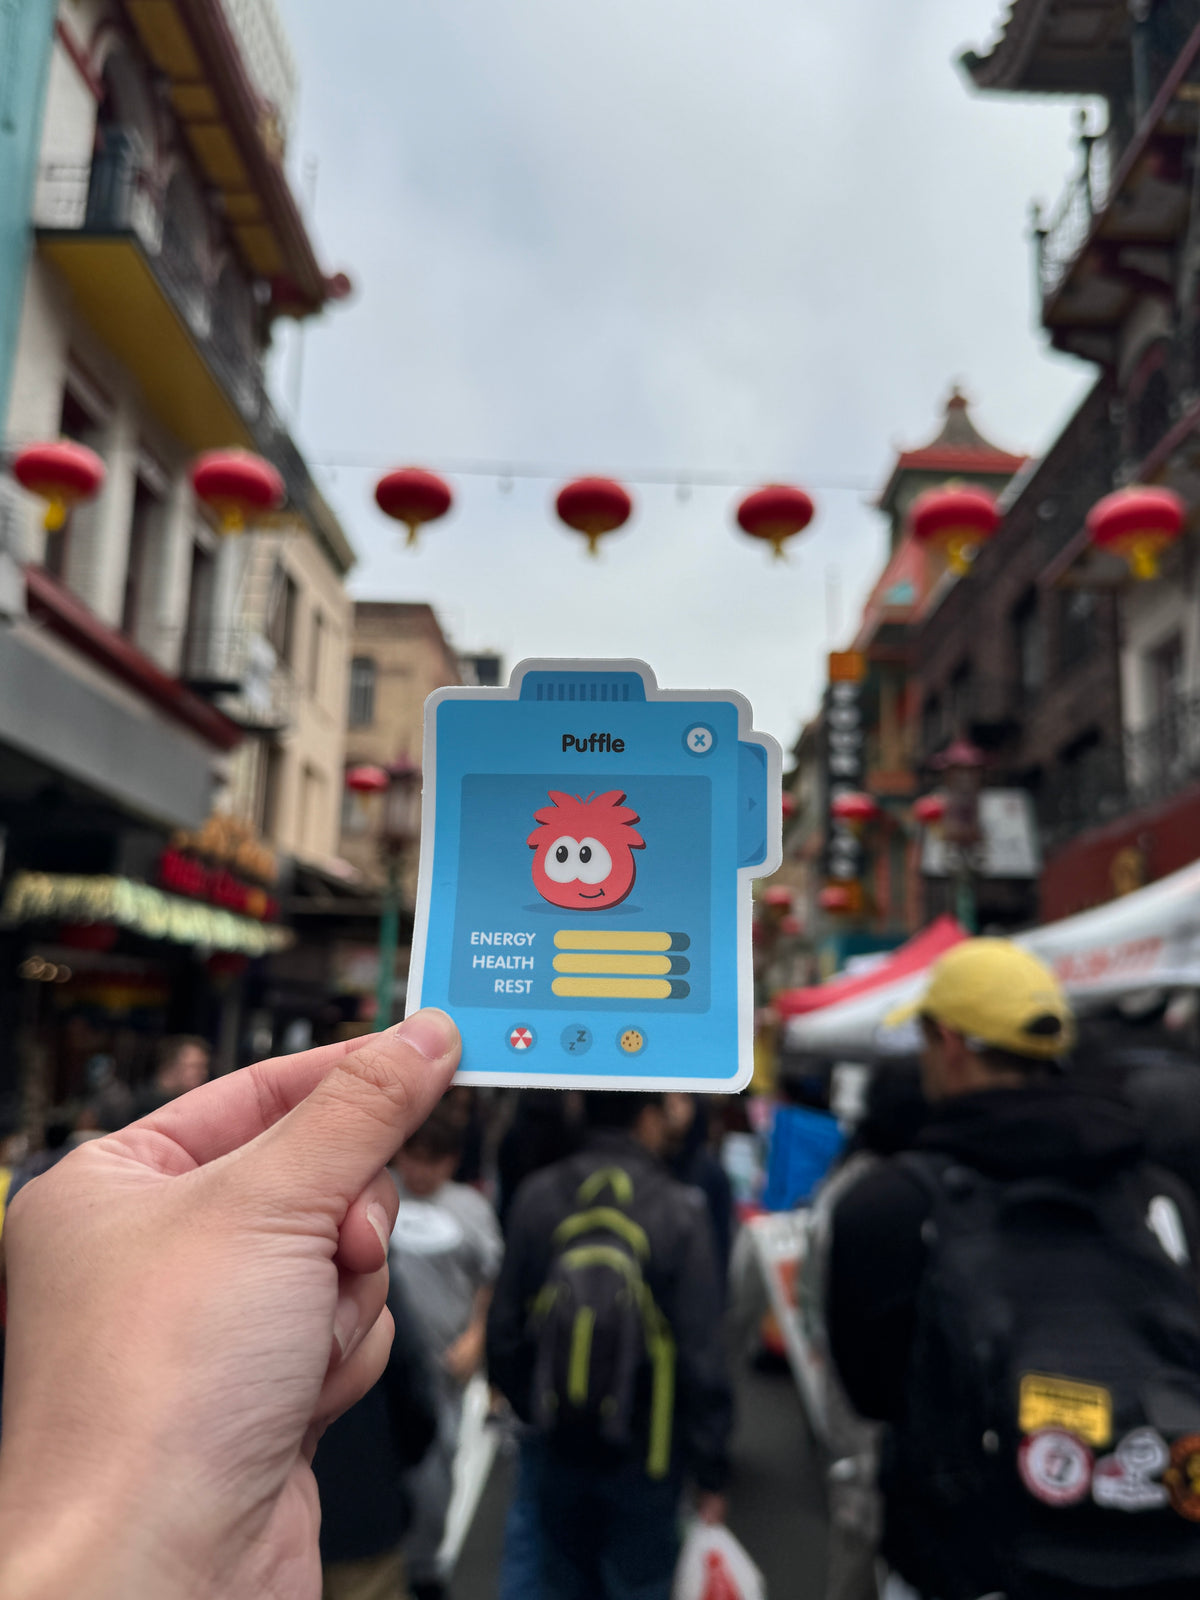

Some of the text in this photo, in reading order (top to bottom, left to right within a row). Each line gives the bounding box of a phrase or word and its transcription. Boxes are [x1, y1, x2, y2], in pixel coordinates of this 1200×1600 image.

[562, 733, 625, 753] Puffle
[470, 931, 536, 946] ENERGY
[472, 955, 534, 970] HEALTH
[494, 979, 533, 994] REST
